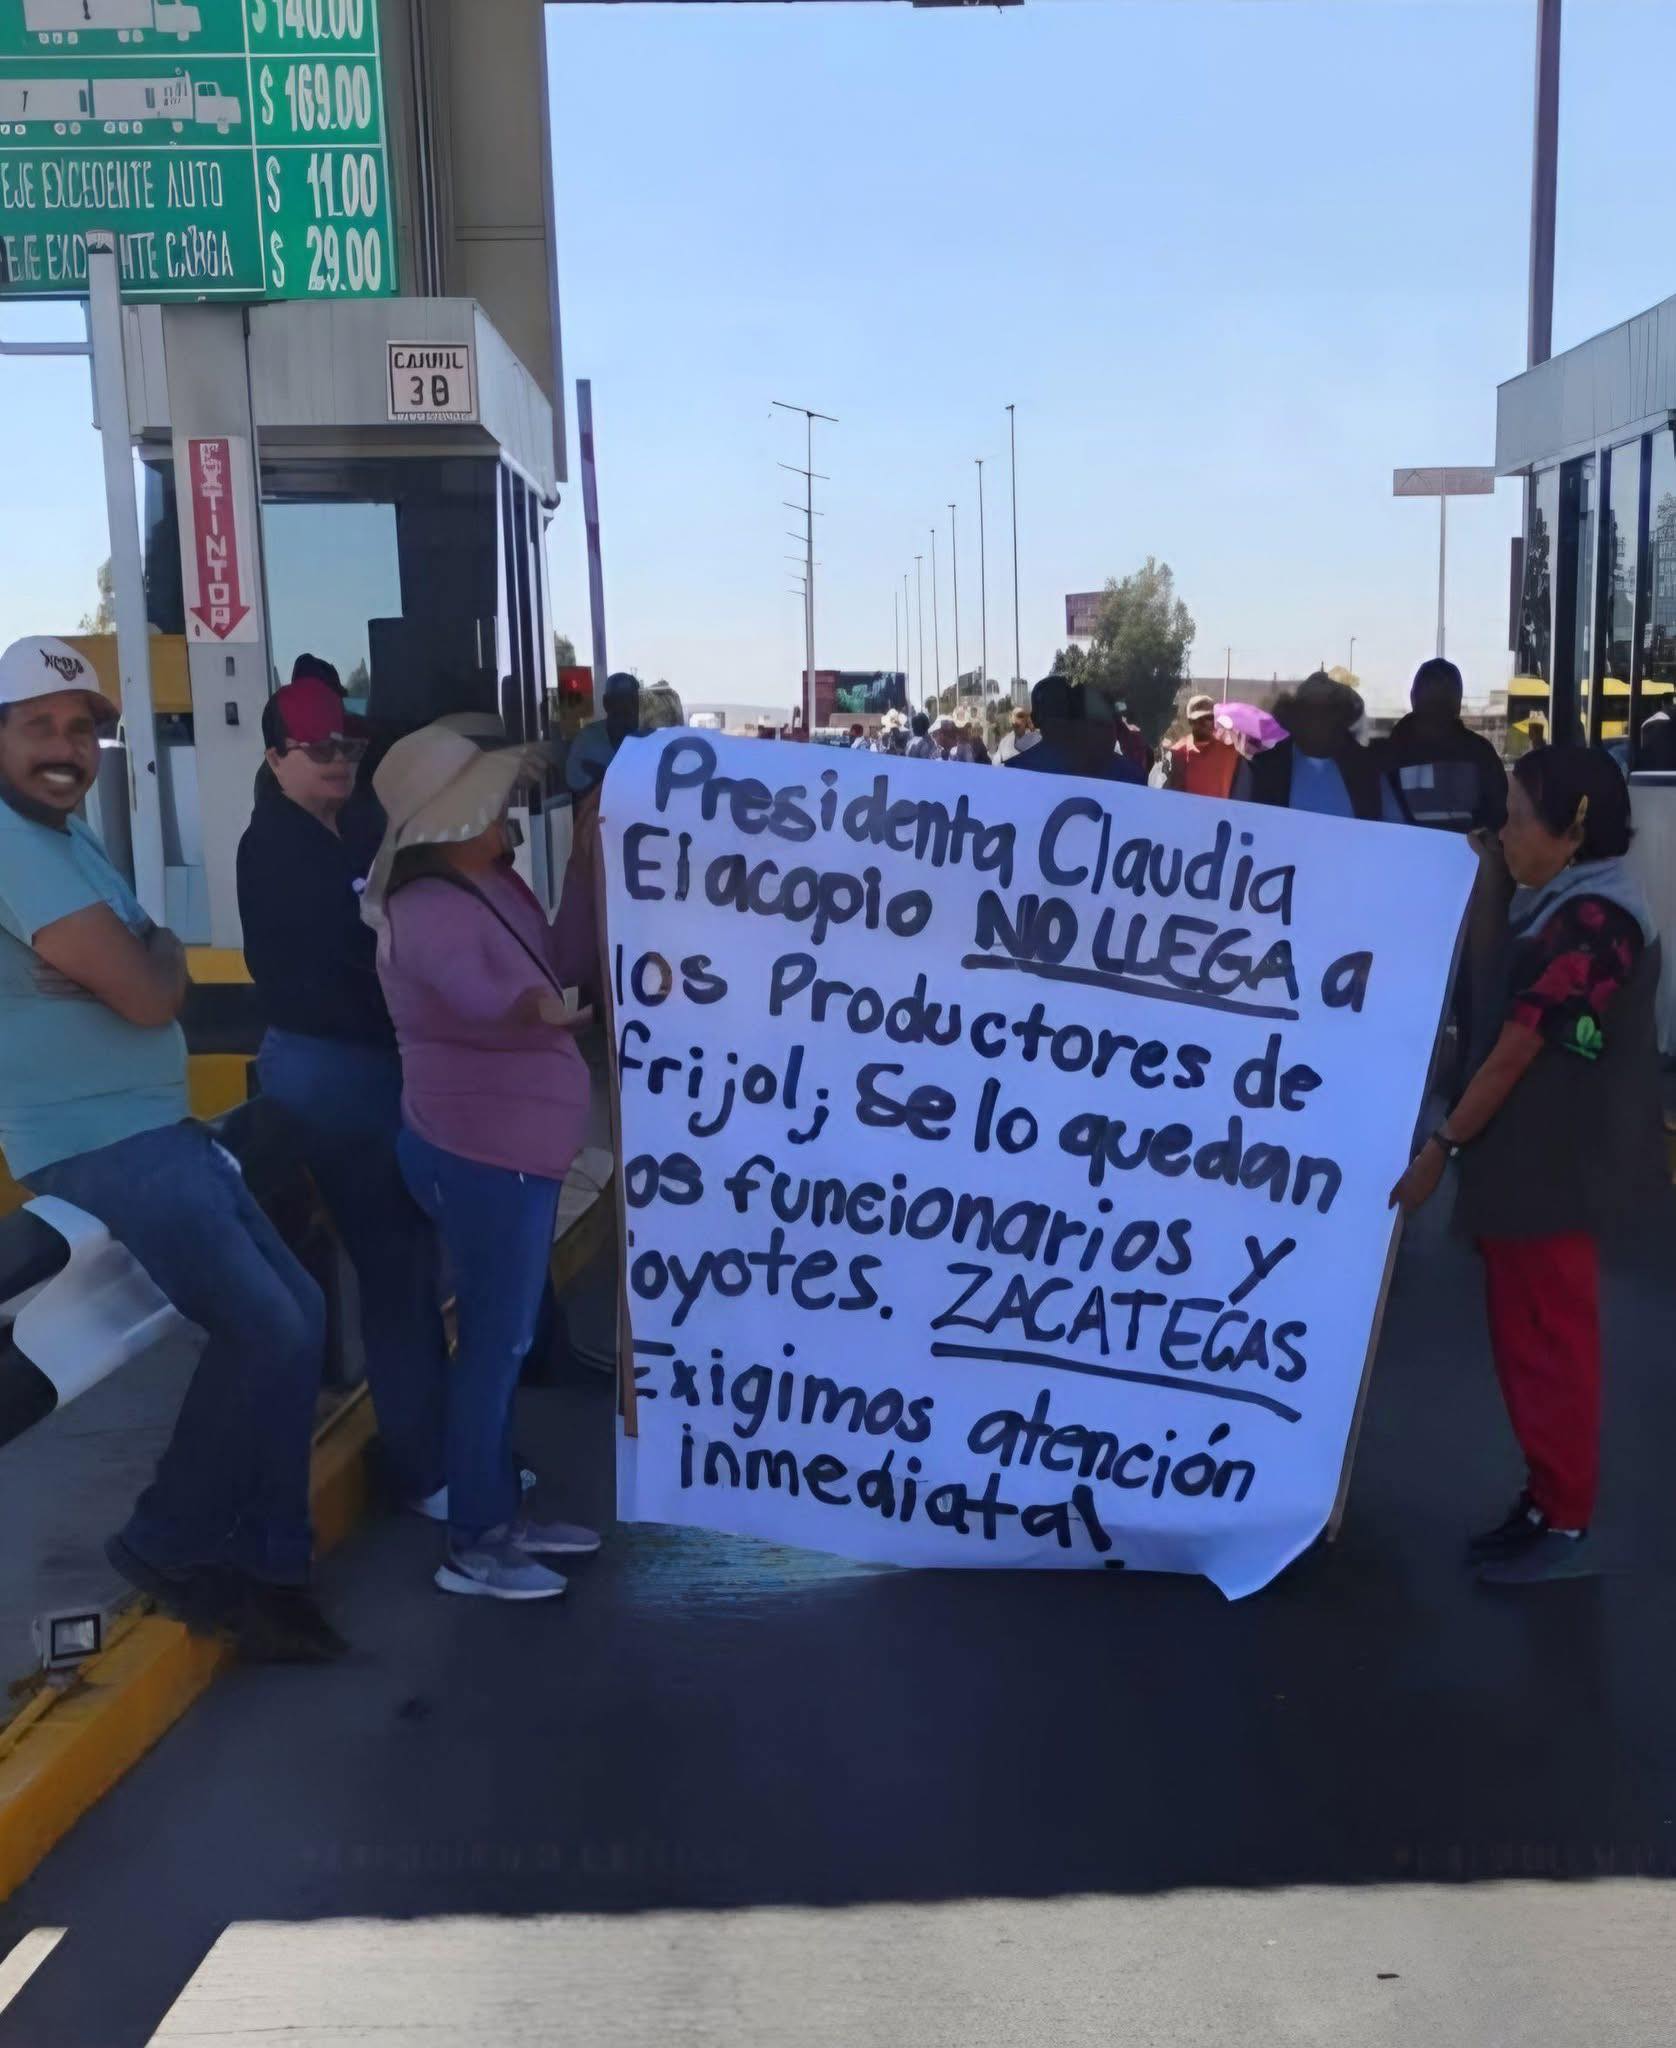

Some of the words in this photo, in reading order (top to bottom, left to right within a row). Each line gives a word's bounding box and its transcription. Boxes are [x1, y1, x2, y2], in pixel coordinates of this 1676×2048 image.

[285, 63, 371, 132] 169.00
[1, 161, 37, 208] EJE
[167, 160, 224, 208] AUTO
[307, 153, 378, 218] 11.00
[306, 224, 381, 292] 29.00
[655, 736, 1016, 889] Presidenta
[1038, 796, 1296, 926] Claudia
[623, 822, 693, 902] El
[704, 853, 933, 946] acopio
[975, 889, 1079, 965] NO
[1092, 906, 1300, 1001] LLEGA
[1320, 950, 1374, 1013] a
[616, 943, 728, 1008] los
[768, 952, 1212, 1090] Productores
[1233, 1033, 1323, 1112] de
[856, 1063, 957, 1141] Se
[973, 1077, 1039, 1154] lo
[1058, 1112, 1343, 1214] quedan
[627, 1228, 894, 1328] oyotes.
[966, 1388, 1256, 1502] atención
